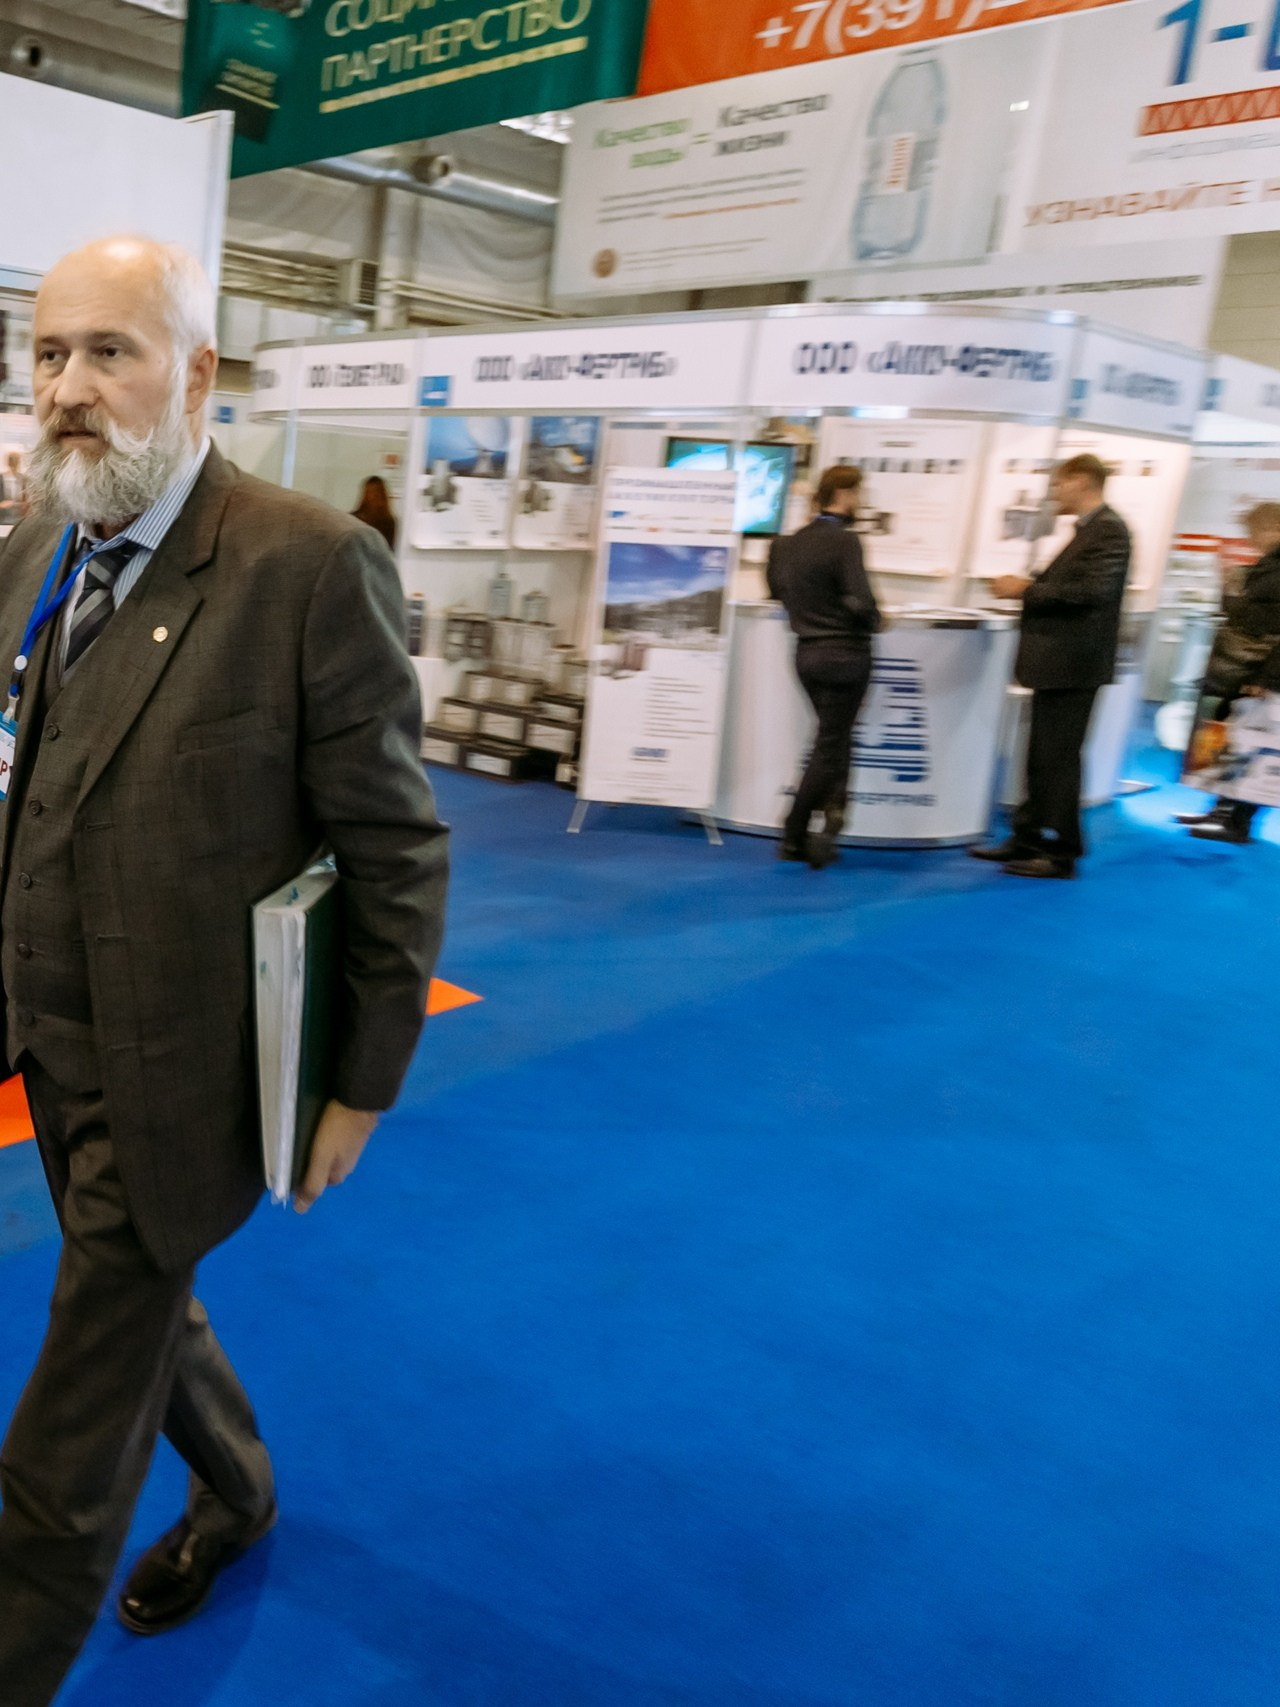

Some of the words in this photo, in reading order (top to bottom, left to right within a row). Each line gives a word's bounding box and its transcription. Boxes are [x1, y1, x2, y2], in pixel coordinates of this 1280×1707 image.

[321, 0, 592, 91] ПАРТНЕРСТВО
[716, 94, 830, 128] Качество
[1024, 179, 1254, 227] УЗНАВАЙТЕ
[793, 342, 856, 375] ООО
